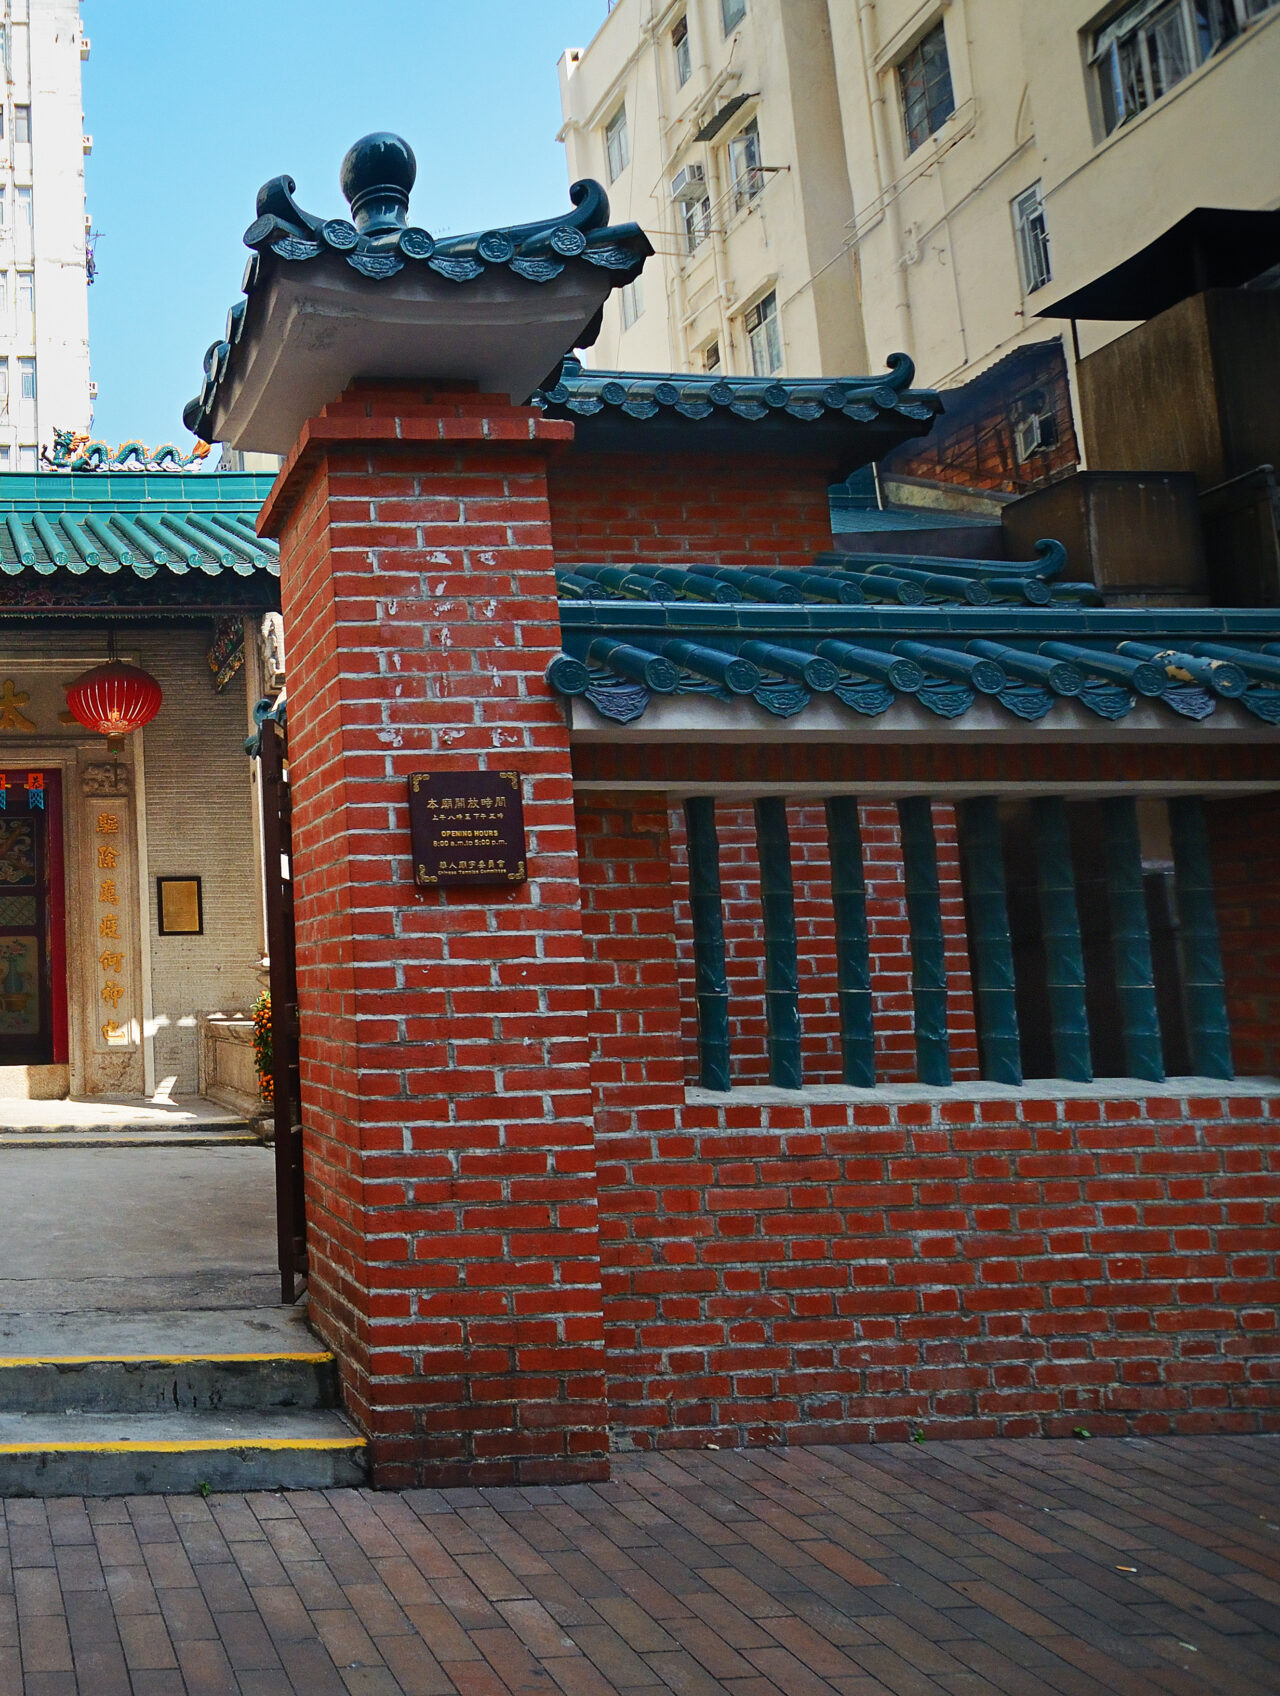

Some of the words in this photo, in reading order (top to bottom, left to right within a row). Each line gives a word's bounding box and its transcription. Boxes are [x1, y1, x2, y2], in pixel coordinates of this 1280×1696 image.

[426, 796, 506, 809] 本廟開放時間
